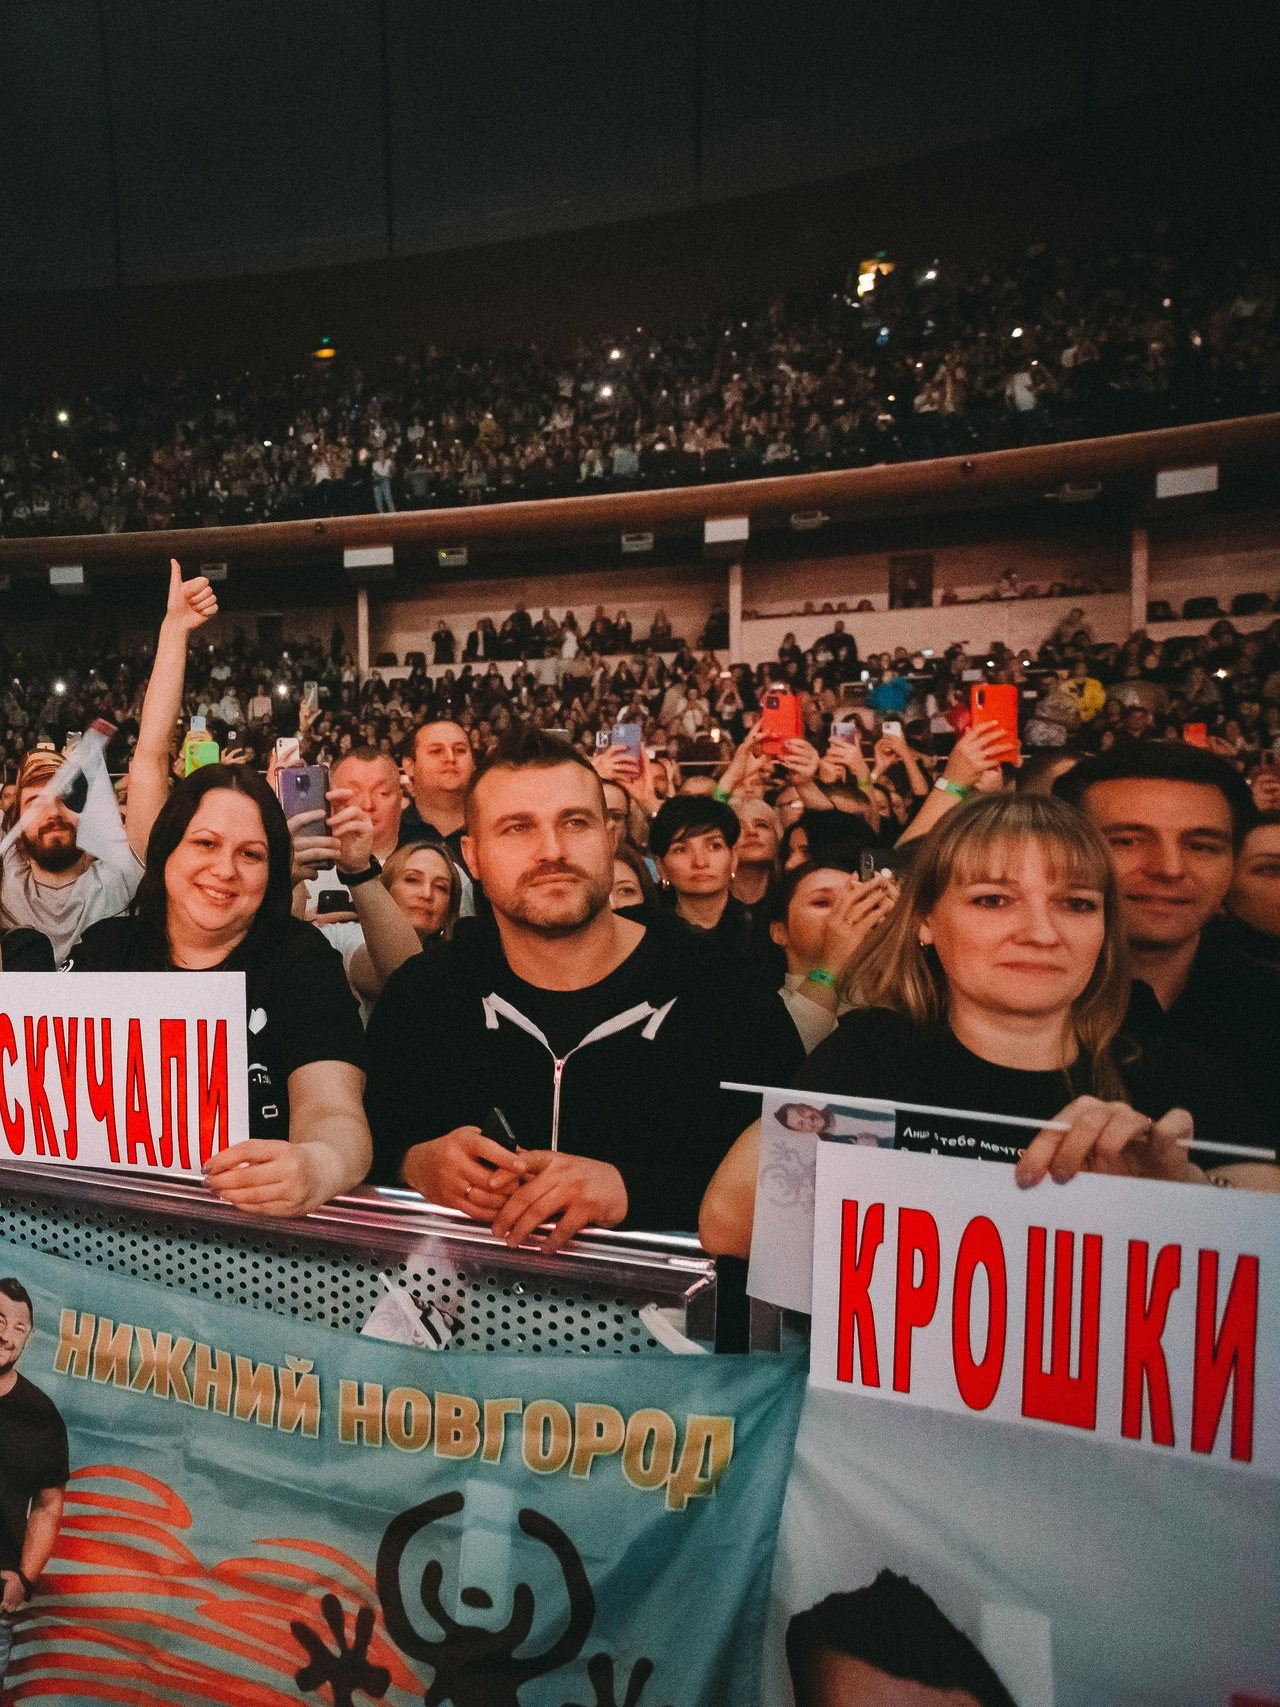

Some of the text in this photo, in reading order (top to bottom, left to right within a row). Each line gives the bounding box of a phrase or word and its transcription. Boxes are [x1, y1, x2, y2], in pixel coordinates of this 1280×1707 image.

[940, 1135, 976, 1148] тебе
[53, 1308, 321, 1437] НИЖНИЙ
[338, 1380, 736, 1511] НОВГОРОД
[837, 1199, 1259, 1463] КРОШКИ
